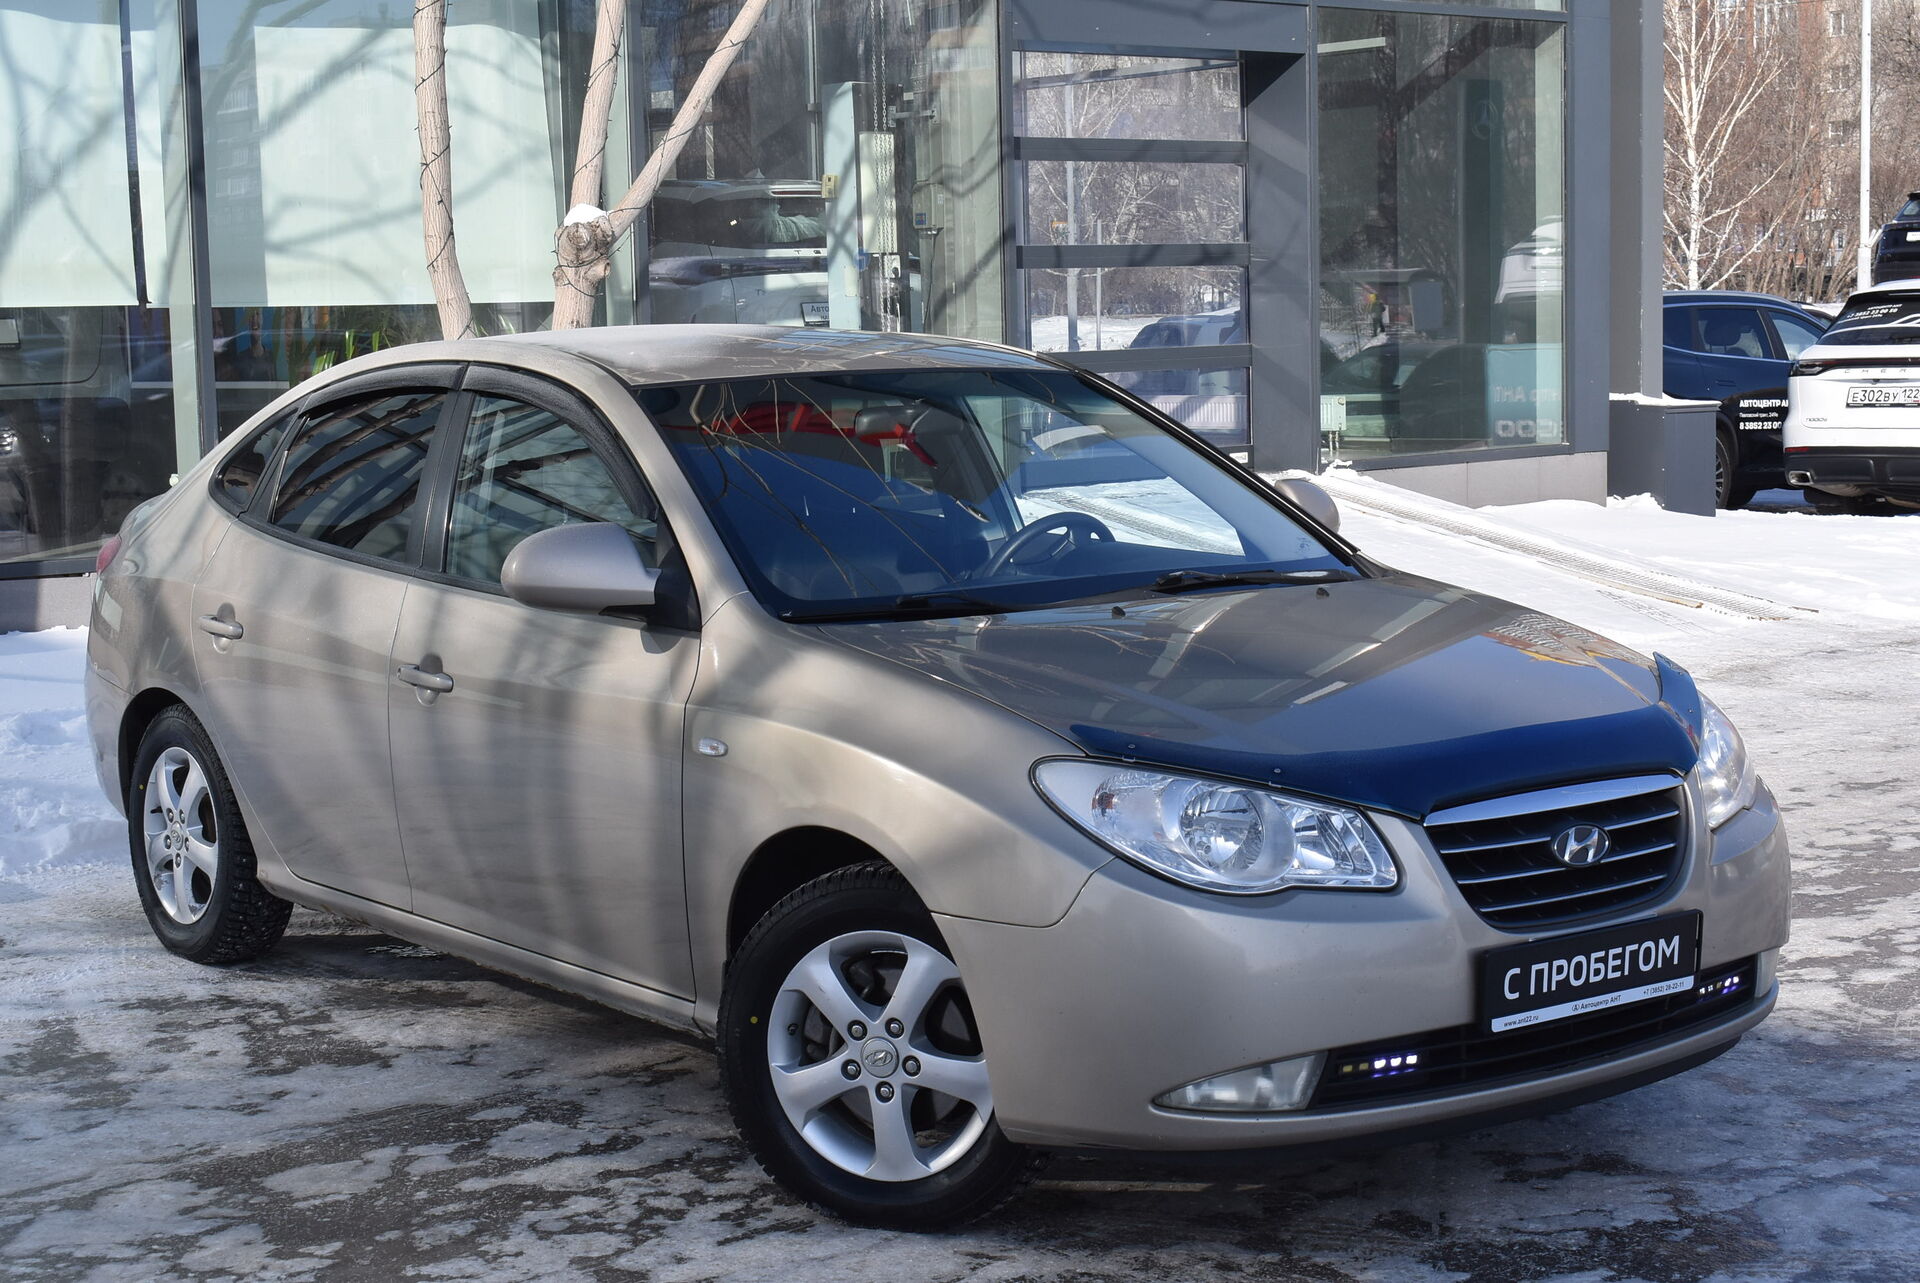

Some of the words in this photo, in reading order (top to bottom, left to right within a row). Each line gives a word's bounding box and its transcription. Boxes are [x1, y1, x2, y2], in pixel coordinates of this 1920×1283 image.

[1739, 399, 1781, 409] АВТОЦЕНТР
[1739, 421, 1745, 430] 8
[1745, 421, 1763, 430] 3852
[1763, 421, 1772, 430] 23
[1503, 967, 1521, 1000] С
[1529, 935, 1680, 996] ПРОБЕГОМ
[1580, 998, 1609, 1011] Автоцентр
[1609, 994, 1622, 1004] АНТ
[1503, 1015, 1540, 1028] www.ant22.ru
